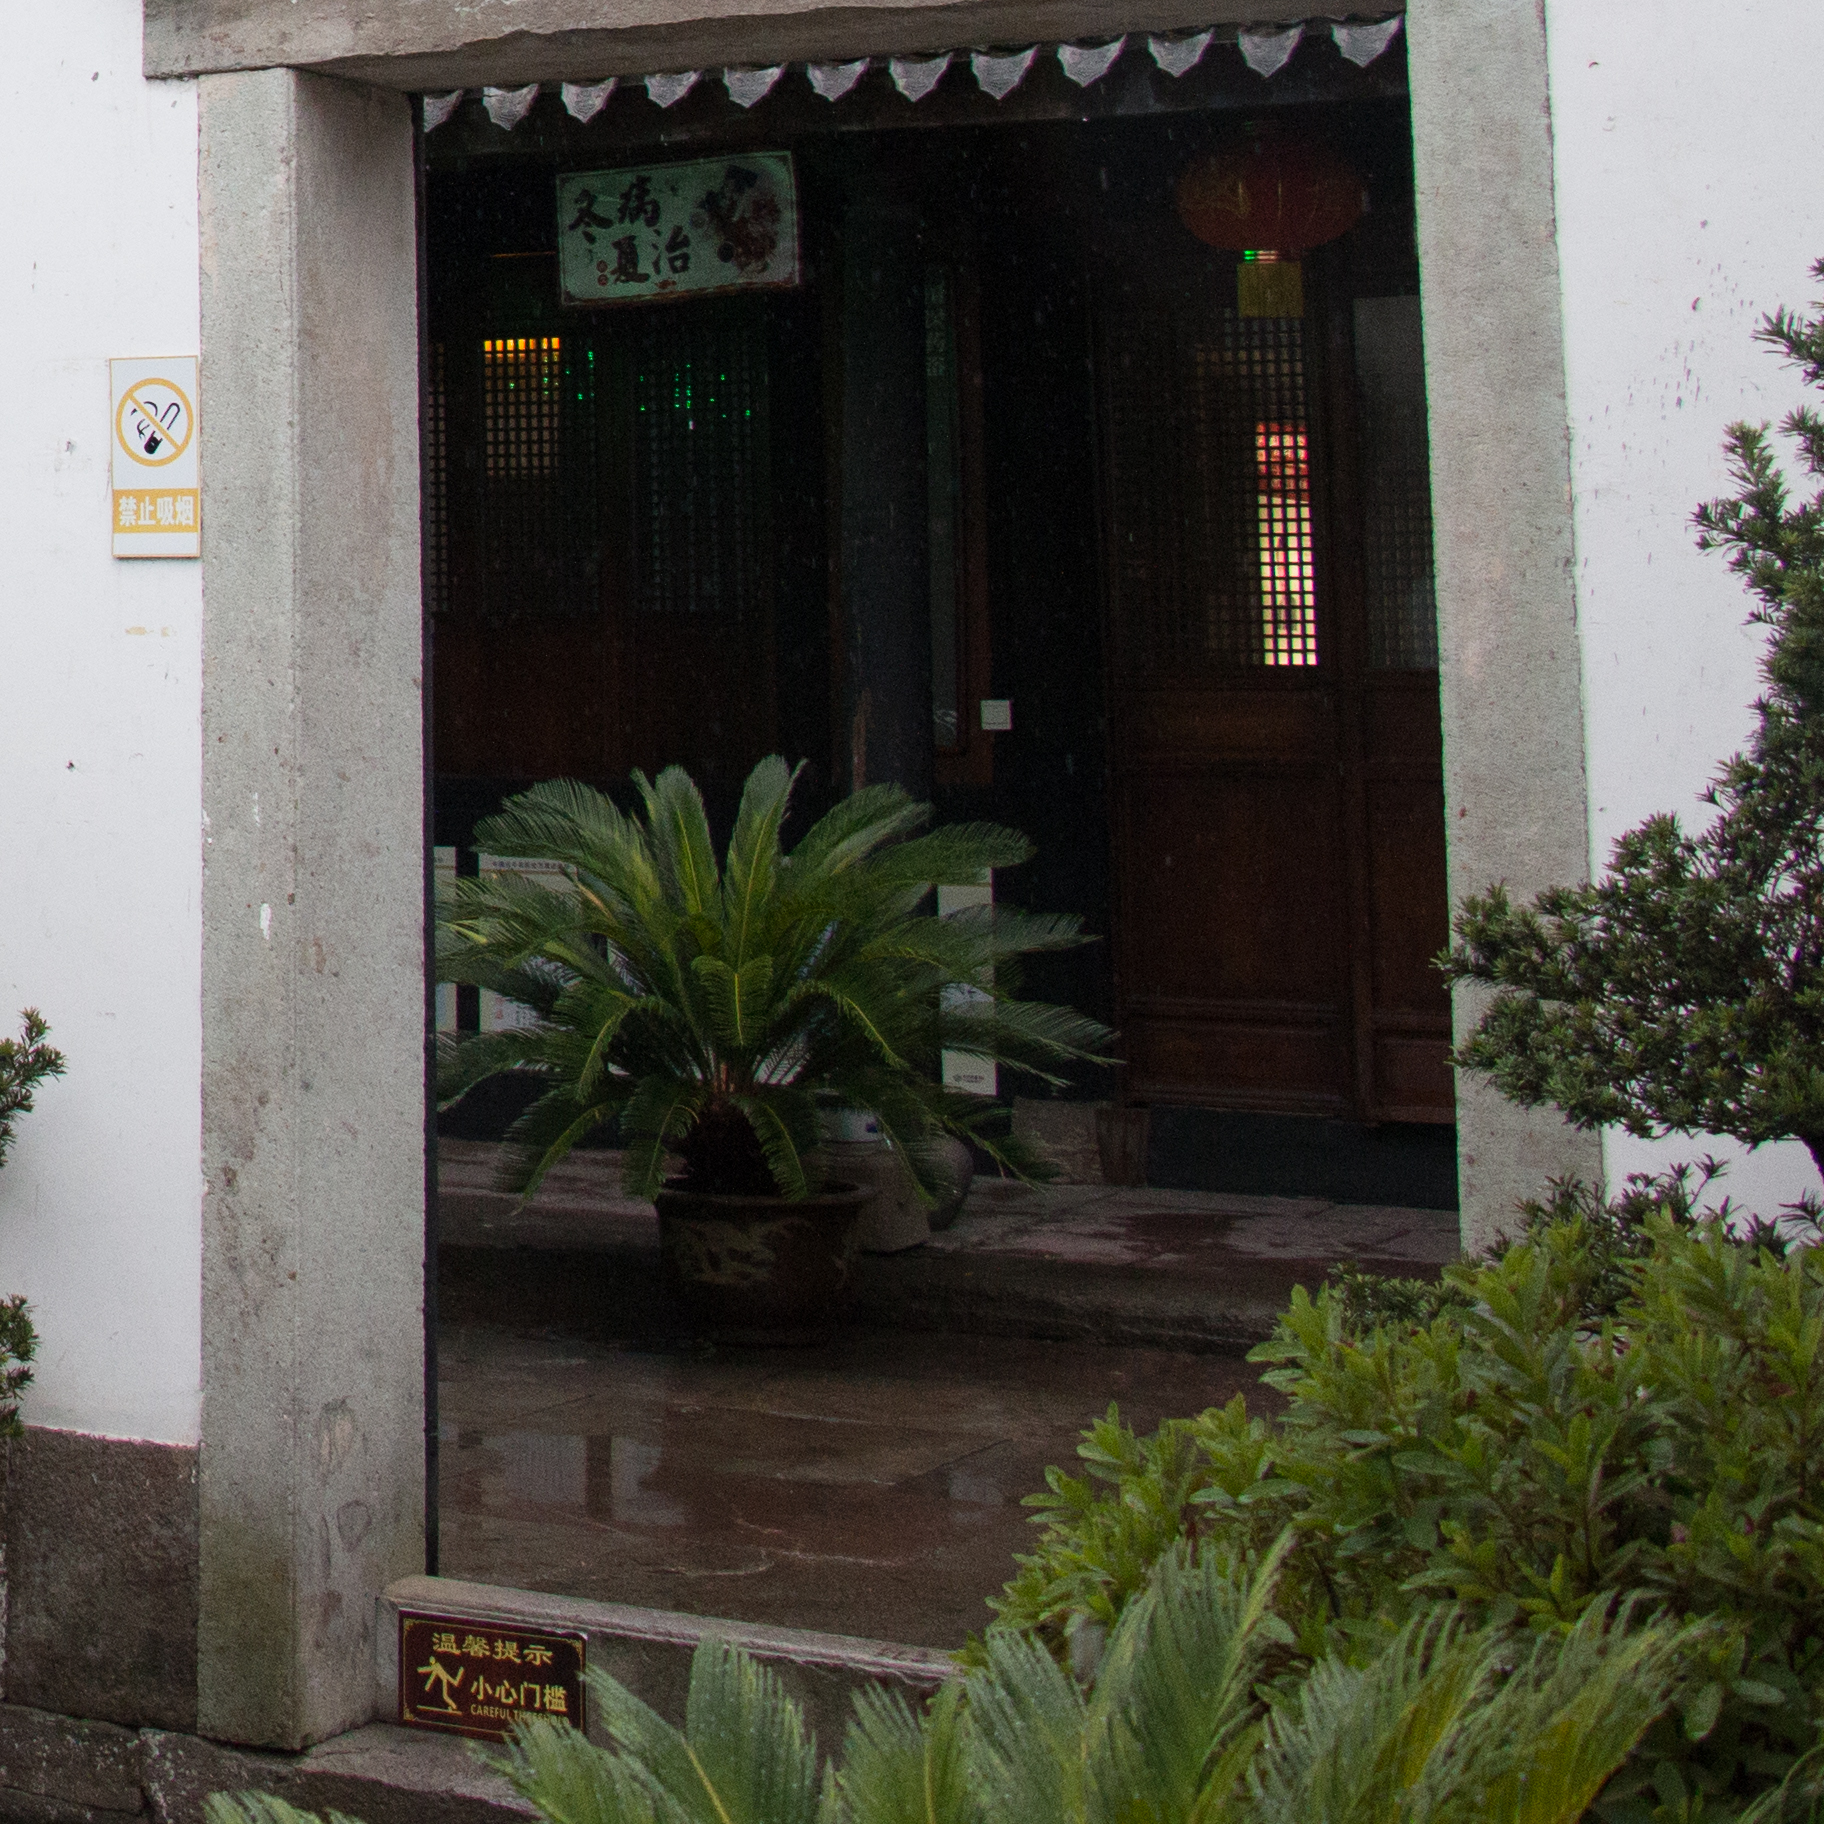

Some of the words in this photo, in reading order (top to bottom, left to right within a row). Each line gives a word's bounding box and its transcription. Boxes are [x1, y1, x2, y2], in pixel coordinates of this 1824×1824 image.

[119, 495, 195, 526] 禁止吸烟
[470, 1676, 567, 1712] 小心门槛
[470, 1704, 511, 1720] CAREFUL
